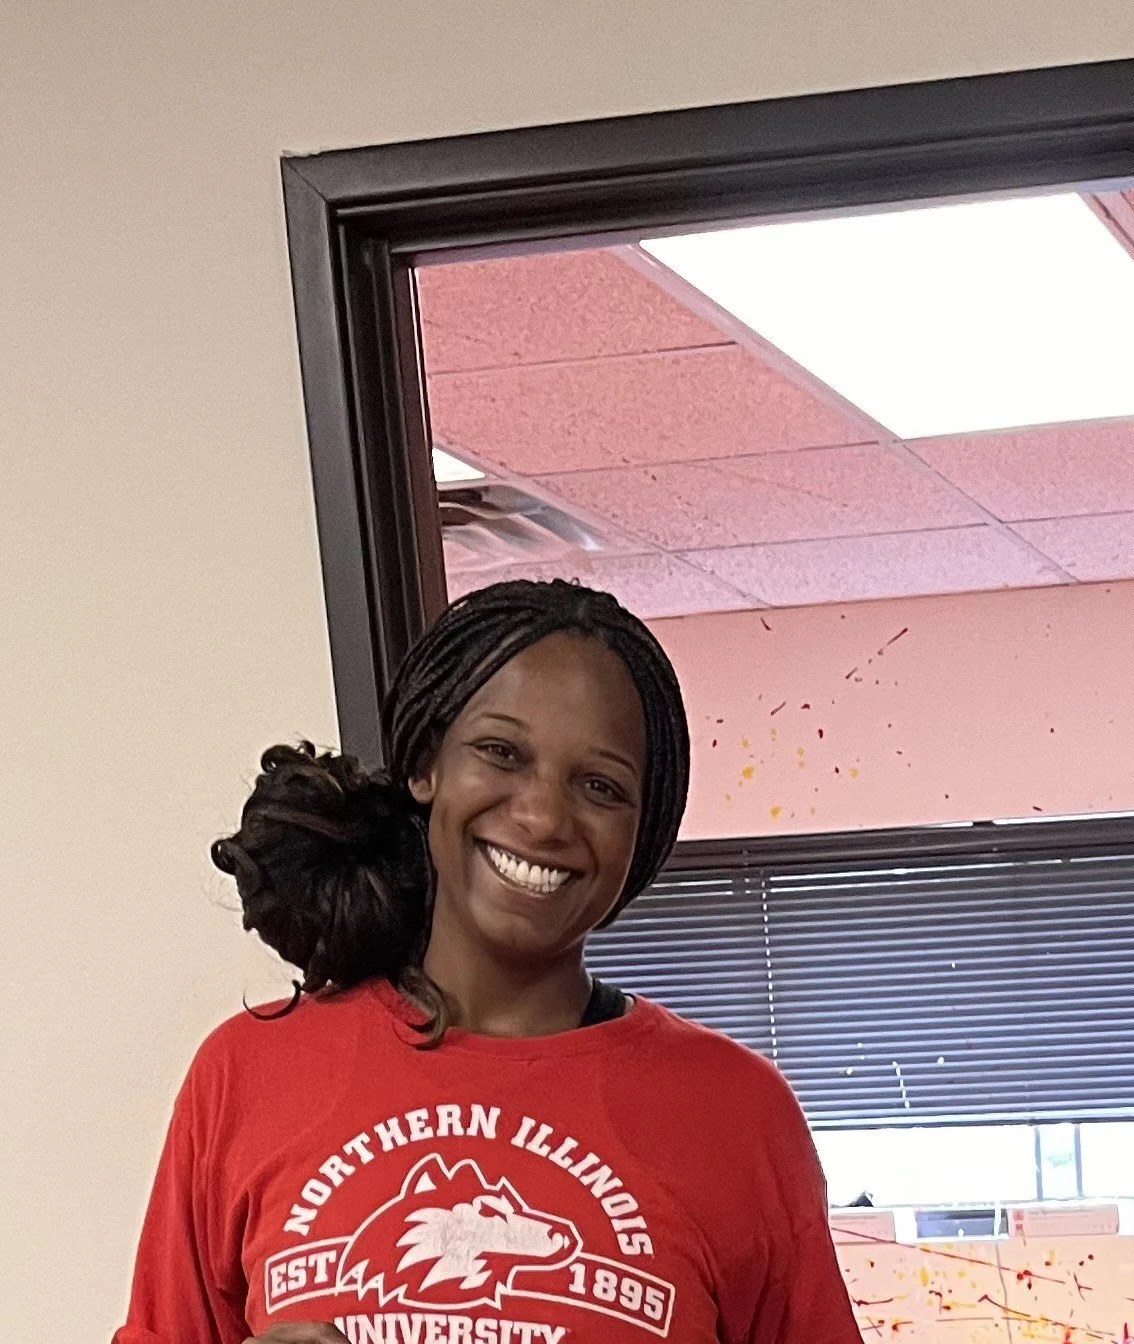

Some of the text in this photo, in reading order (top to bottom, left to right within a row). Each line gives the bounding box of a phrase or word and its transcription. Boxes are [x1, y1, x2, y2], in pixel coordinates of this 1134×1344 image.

[283, 1103, 655, 1260] NORTHERN ILLINOIS
[270, 1249, 337, 1298] EST
[568, 1262, 666, 1321] 1895
